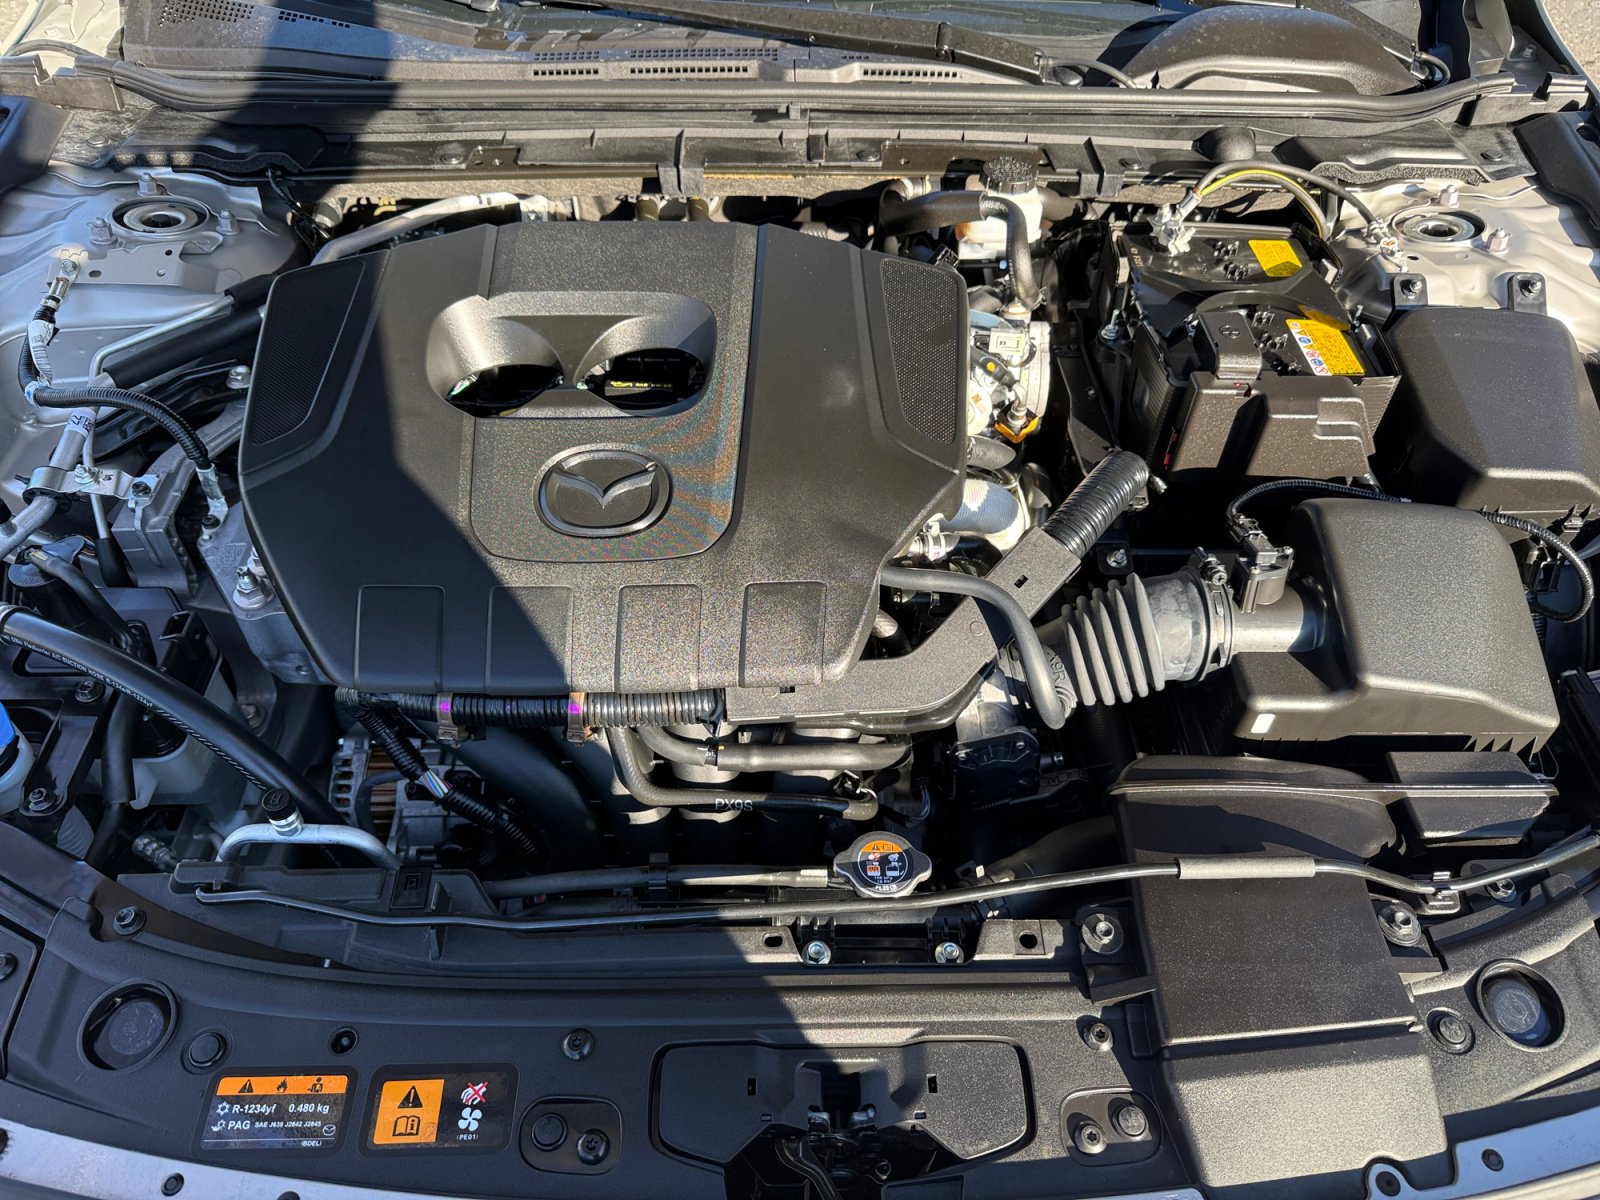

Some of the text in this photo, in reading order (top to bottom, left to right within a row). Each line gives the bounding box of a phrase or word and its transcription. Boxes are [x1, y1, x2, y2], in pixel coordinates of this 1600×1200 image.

[62, 656, 87, 673] SUCTION
[88, 669, 105, 682] HOSE
[715, 798, 753, 811] PX9S
[232, 1103, 330, 1115] R-1234yf 0.480 kg
[227, 1120, 251, 1130] PAG
